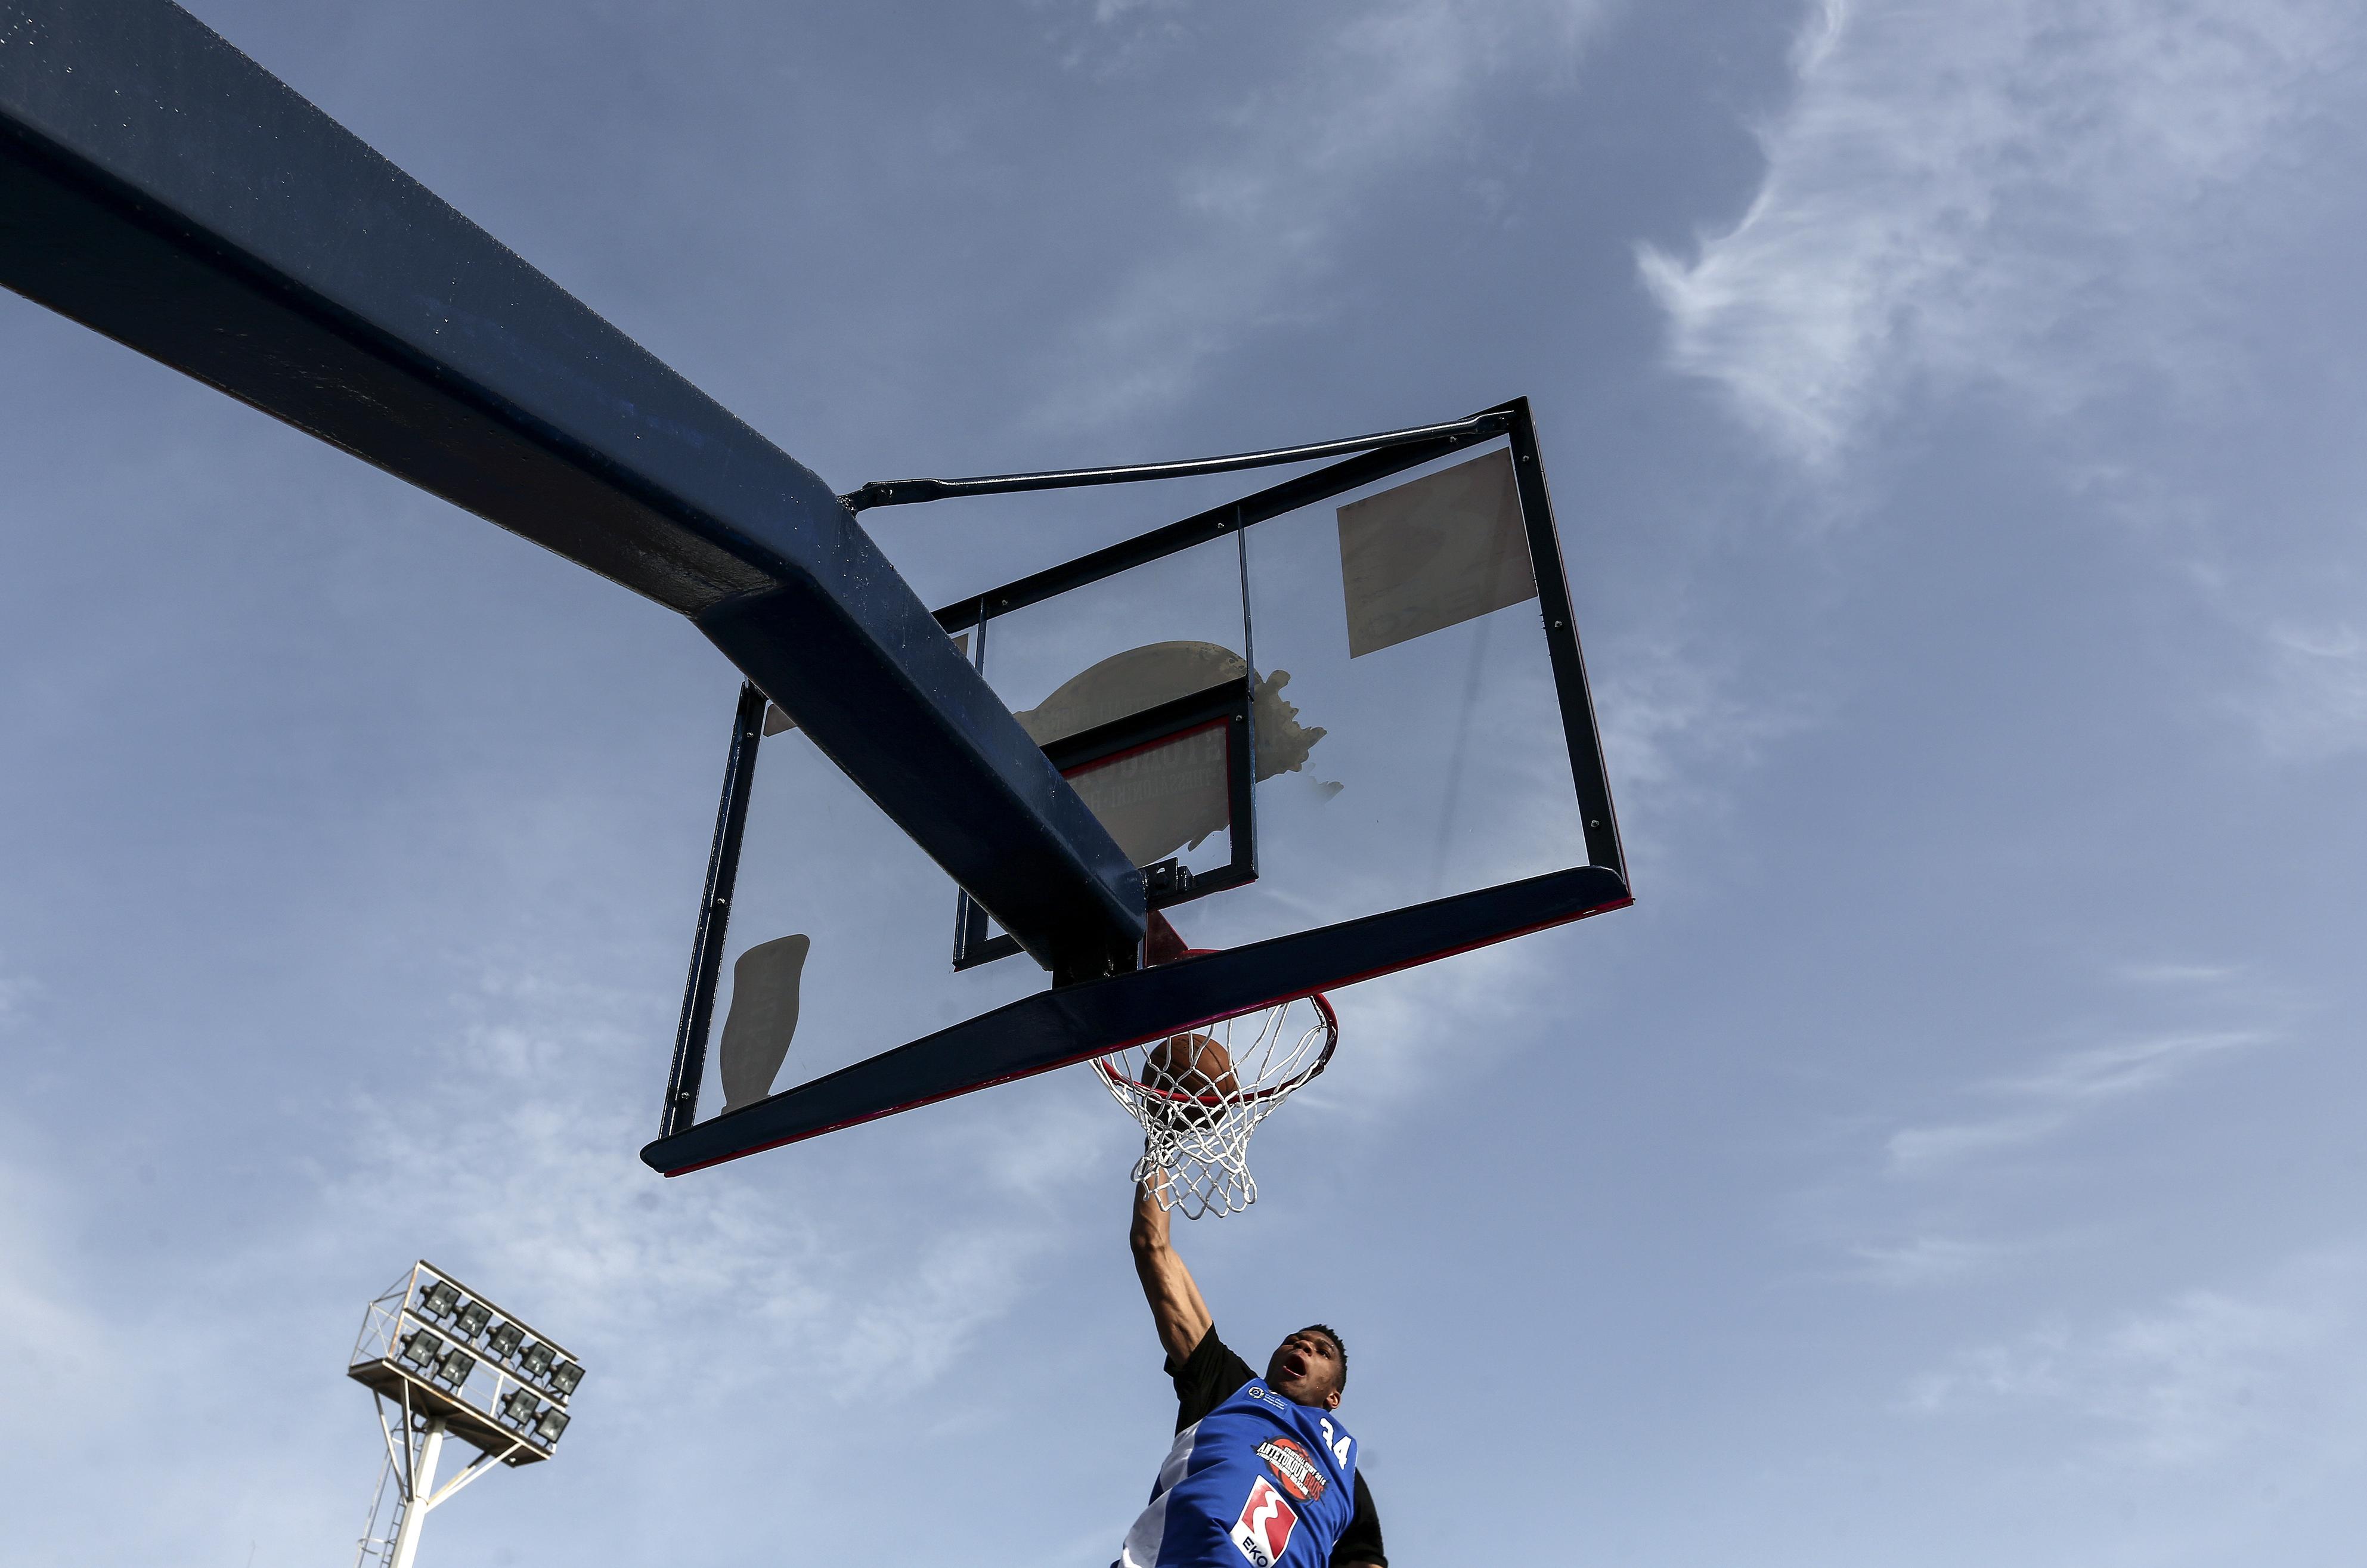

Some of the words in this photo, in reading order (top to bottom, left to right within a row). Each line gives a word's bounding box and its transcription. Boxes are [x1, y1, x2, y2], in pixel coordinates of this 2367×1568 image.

[1319, 1418, 1352, 1470] 34
[1284, 1446, 1305, 1465] STREETBALL
[1304, 1462, 1317, 1476] EVENT
[1315, 1472, 1326, 1486] 2016
[1243, 1536, 1268, 1567] EKO
